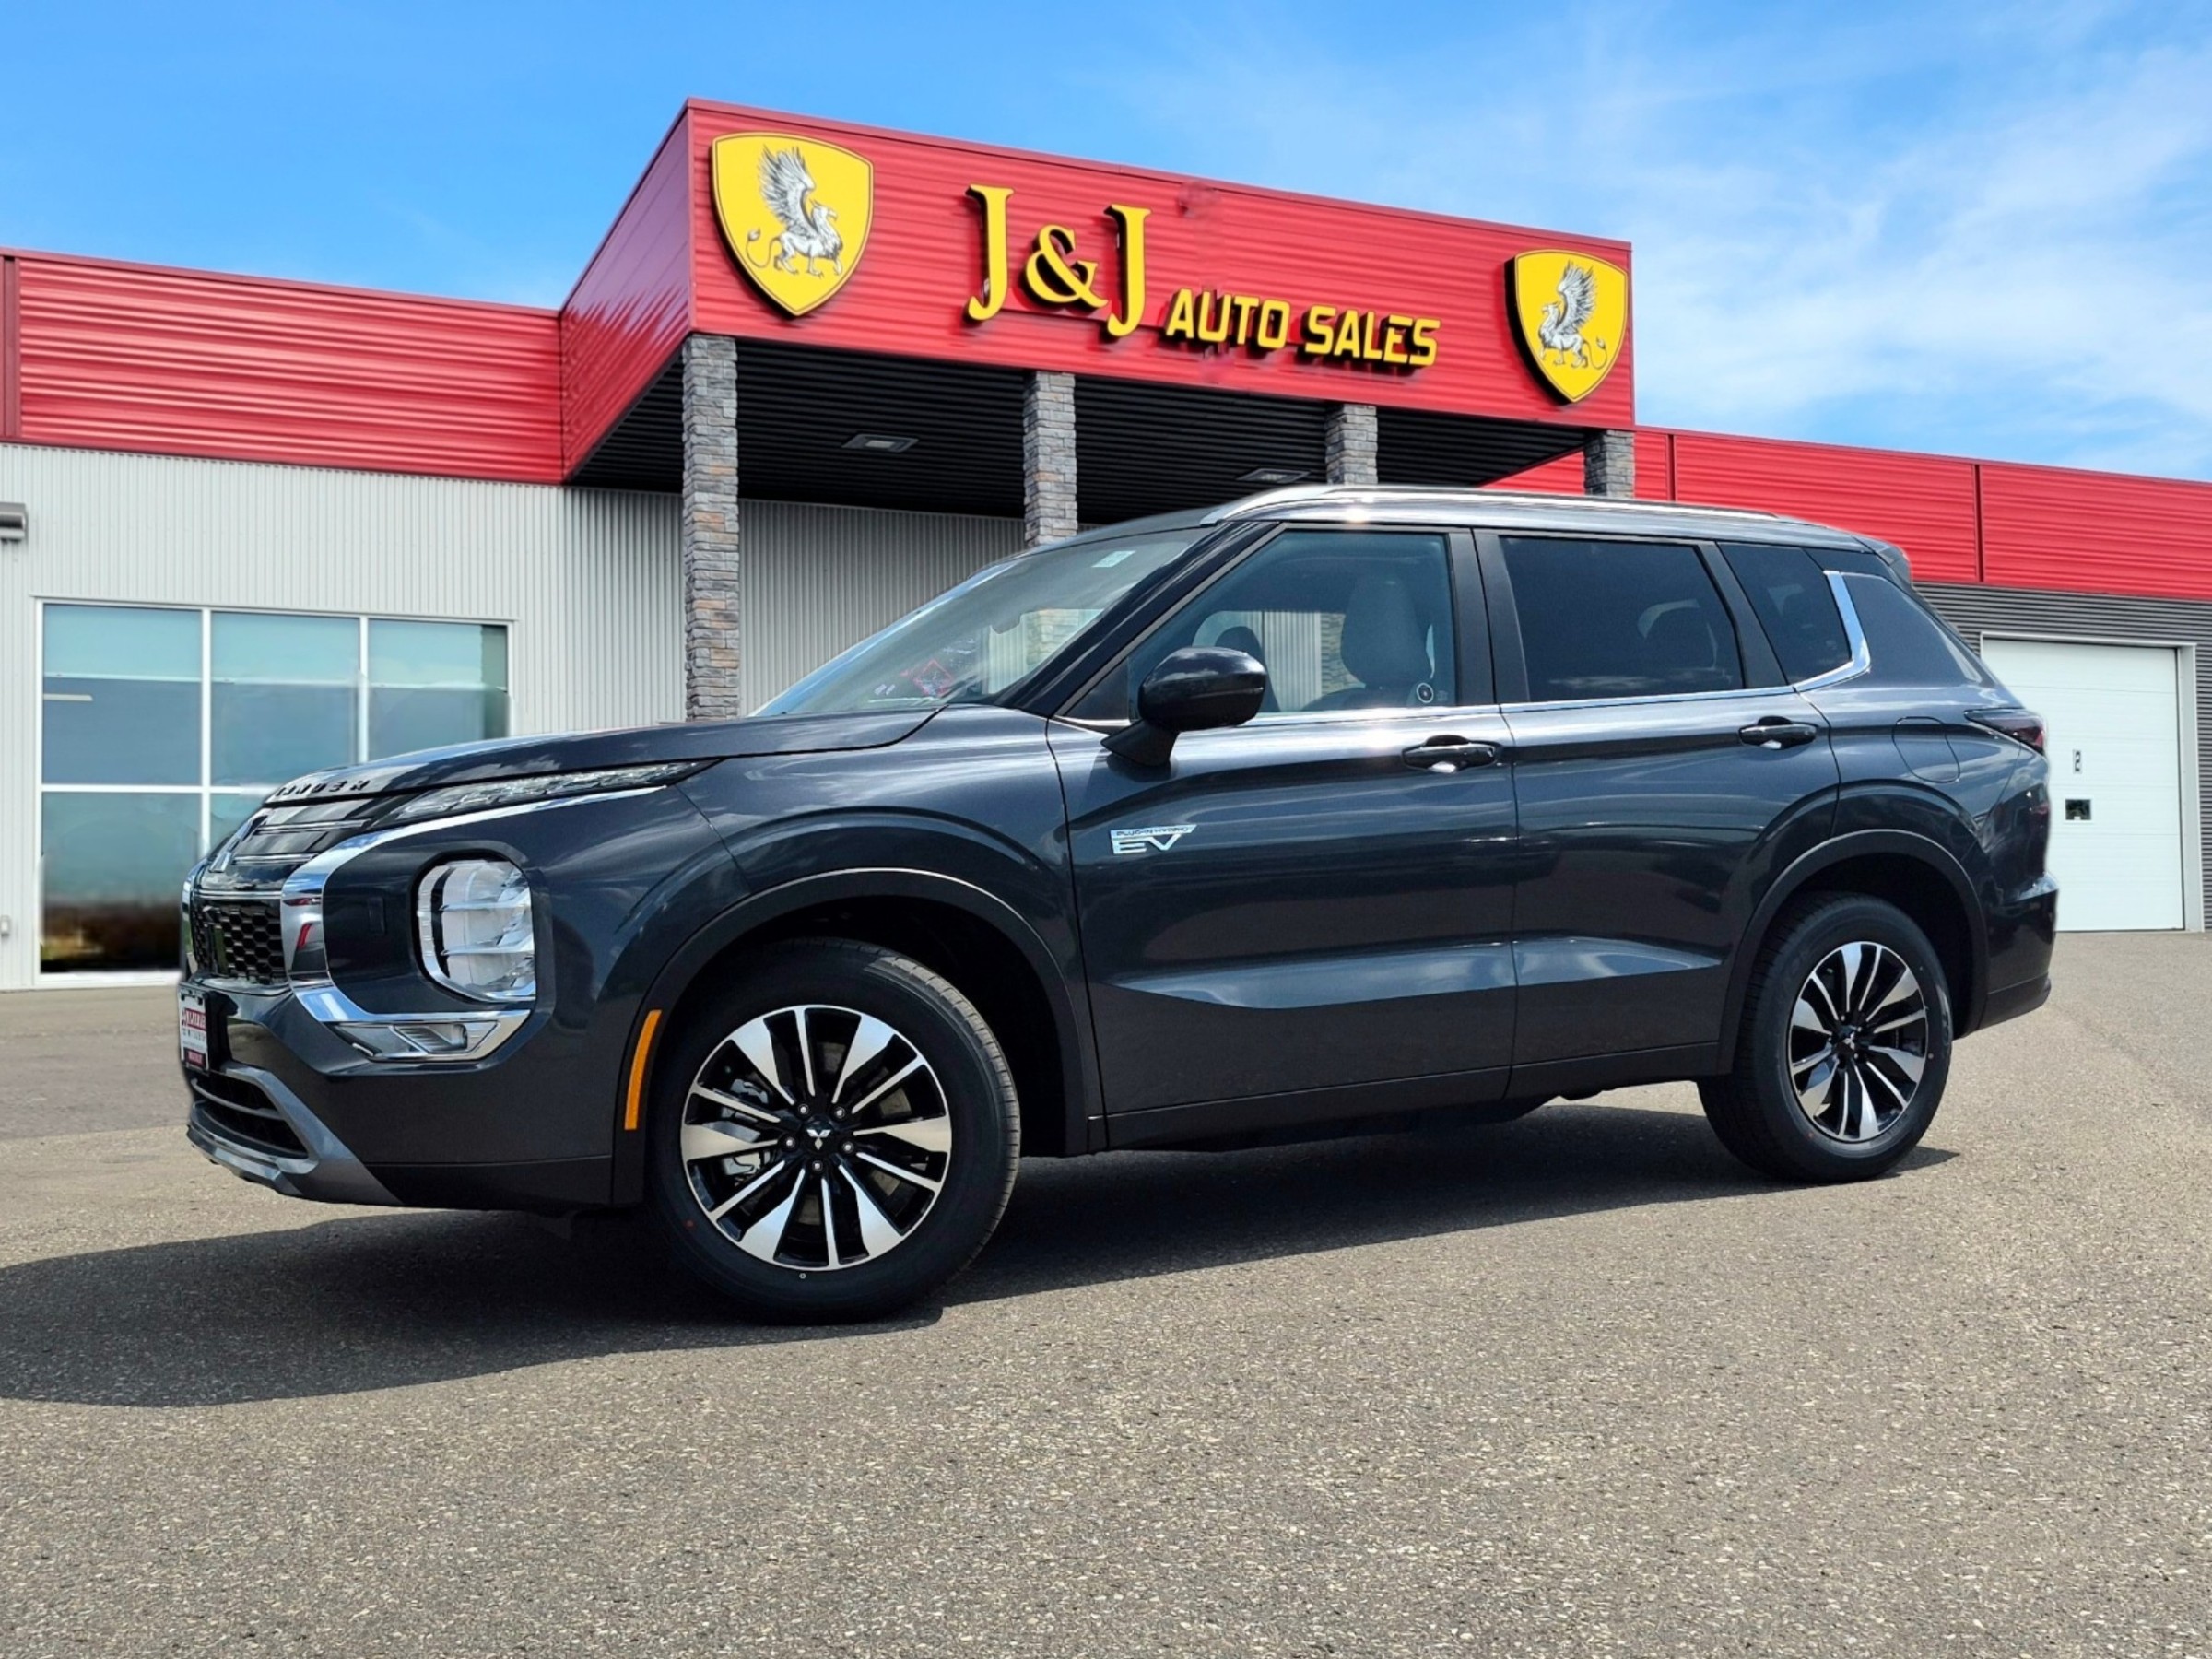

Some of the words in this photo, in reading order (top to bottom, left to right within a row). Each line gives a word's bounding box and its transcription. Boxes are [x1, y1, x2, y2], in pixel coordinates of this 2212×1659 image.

[968, 183, 1152, 337] J&J
[1165, 287, 1291, 350] AUTO
[1304, 302, 1441, 367] SALES
[1111, 834, 1182, 854] EV
